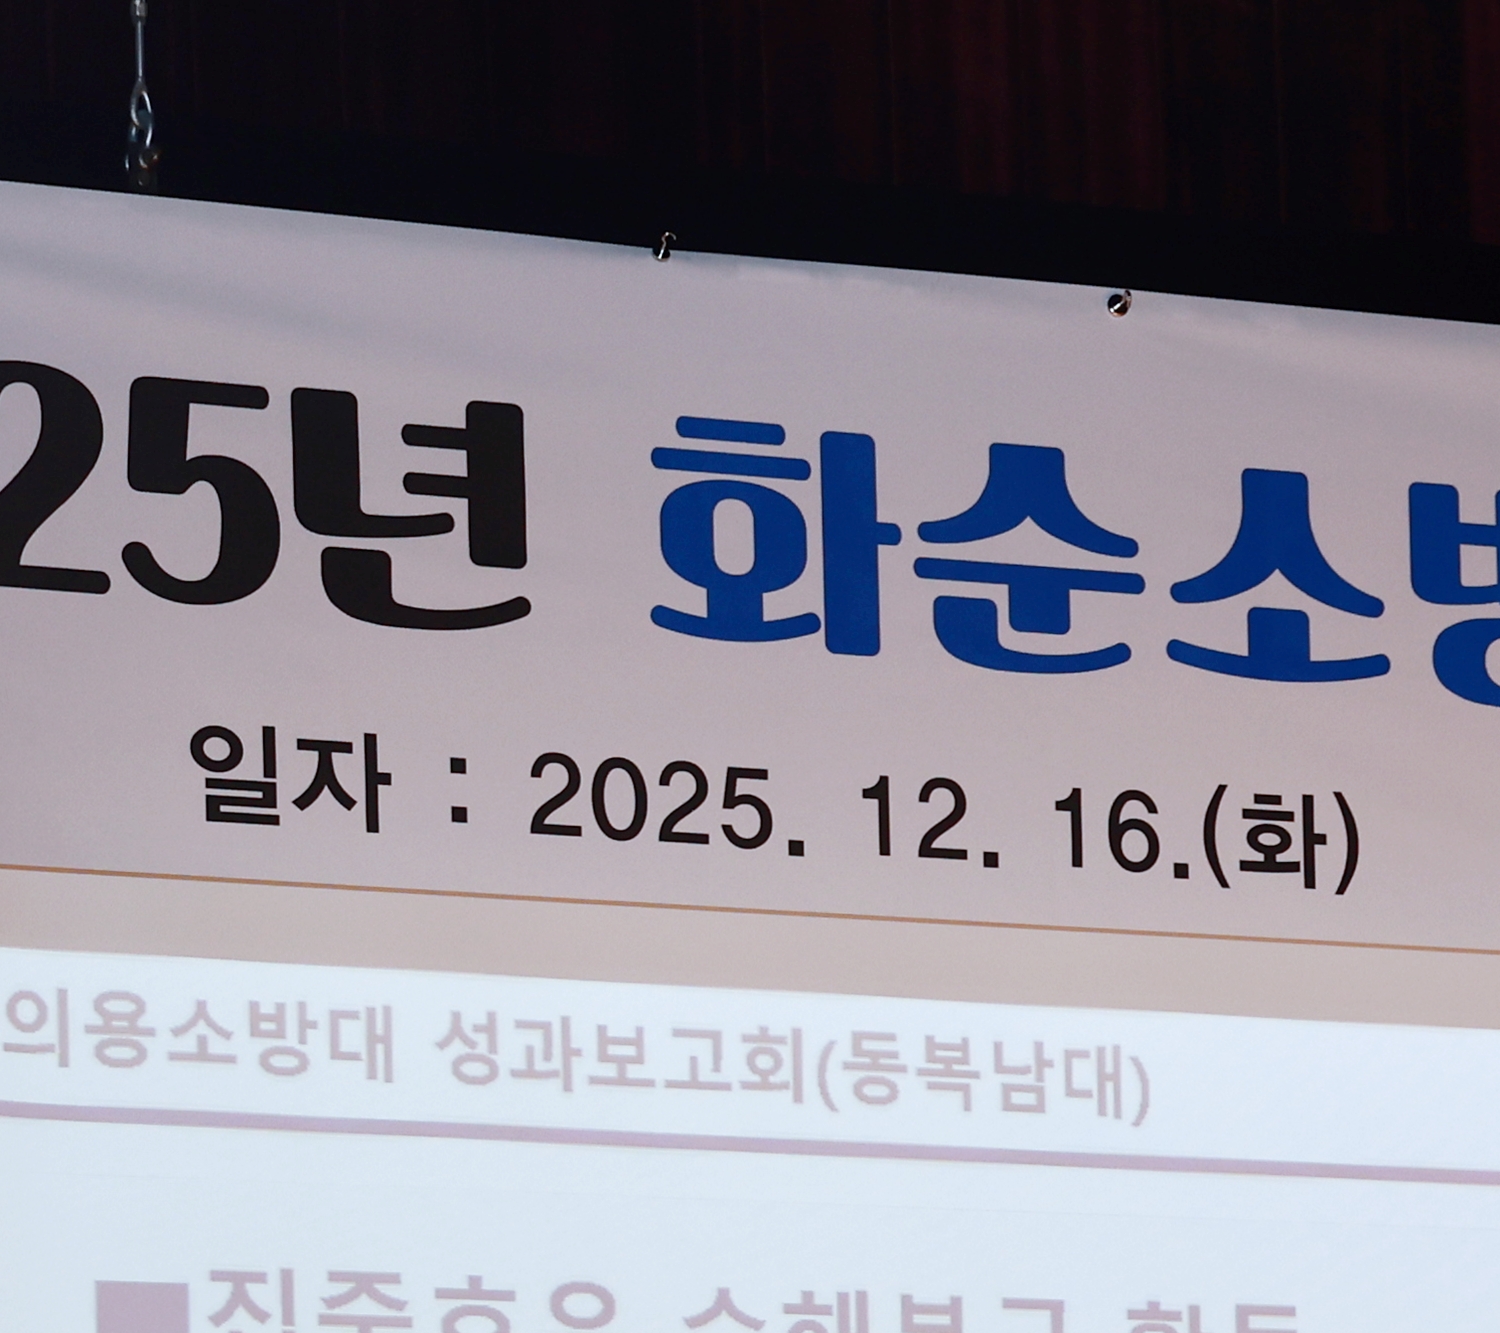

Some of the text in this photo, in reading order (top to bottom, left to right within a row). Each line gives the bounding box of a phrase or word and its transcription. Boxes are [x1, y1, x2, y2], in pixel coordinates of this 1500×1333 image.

[189, 725, 1360, 896] 일자 : 2025. 12. 16.(화)
[2, 987, 1150, 1128] 의용소방대 성과보고회(동복남대)
